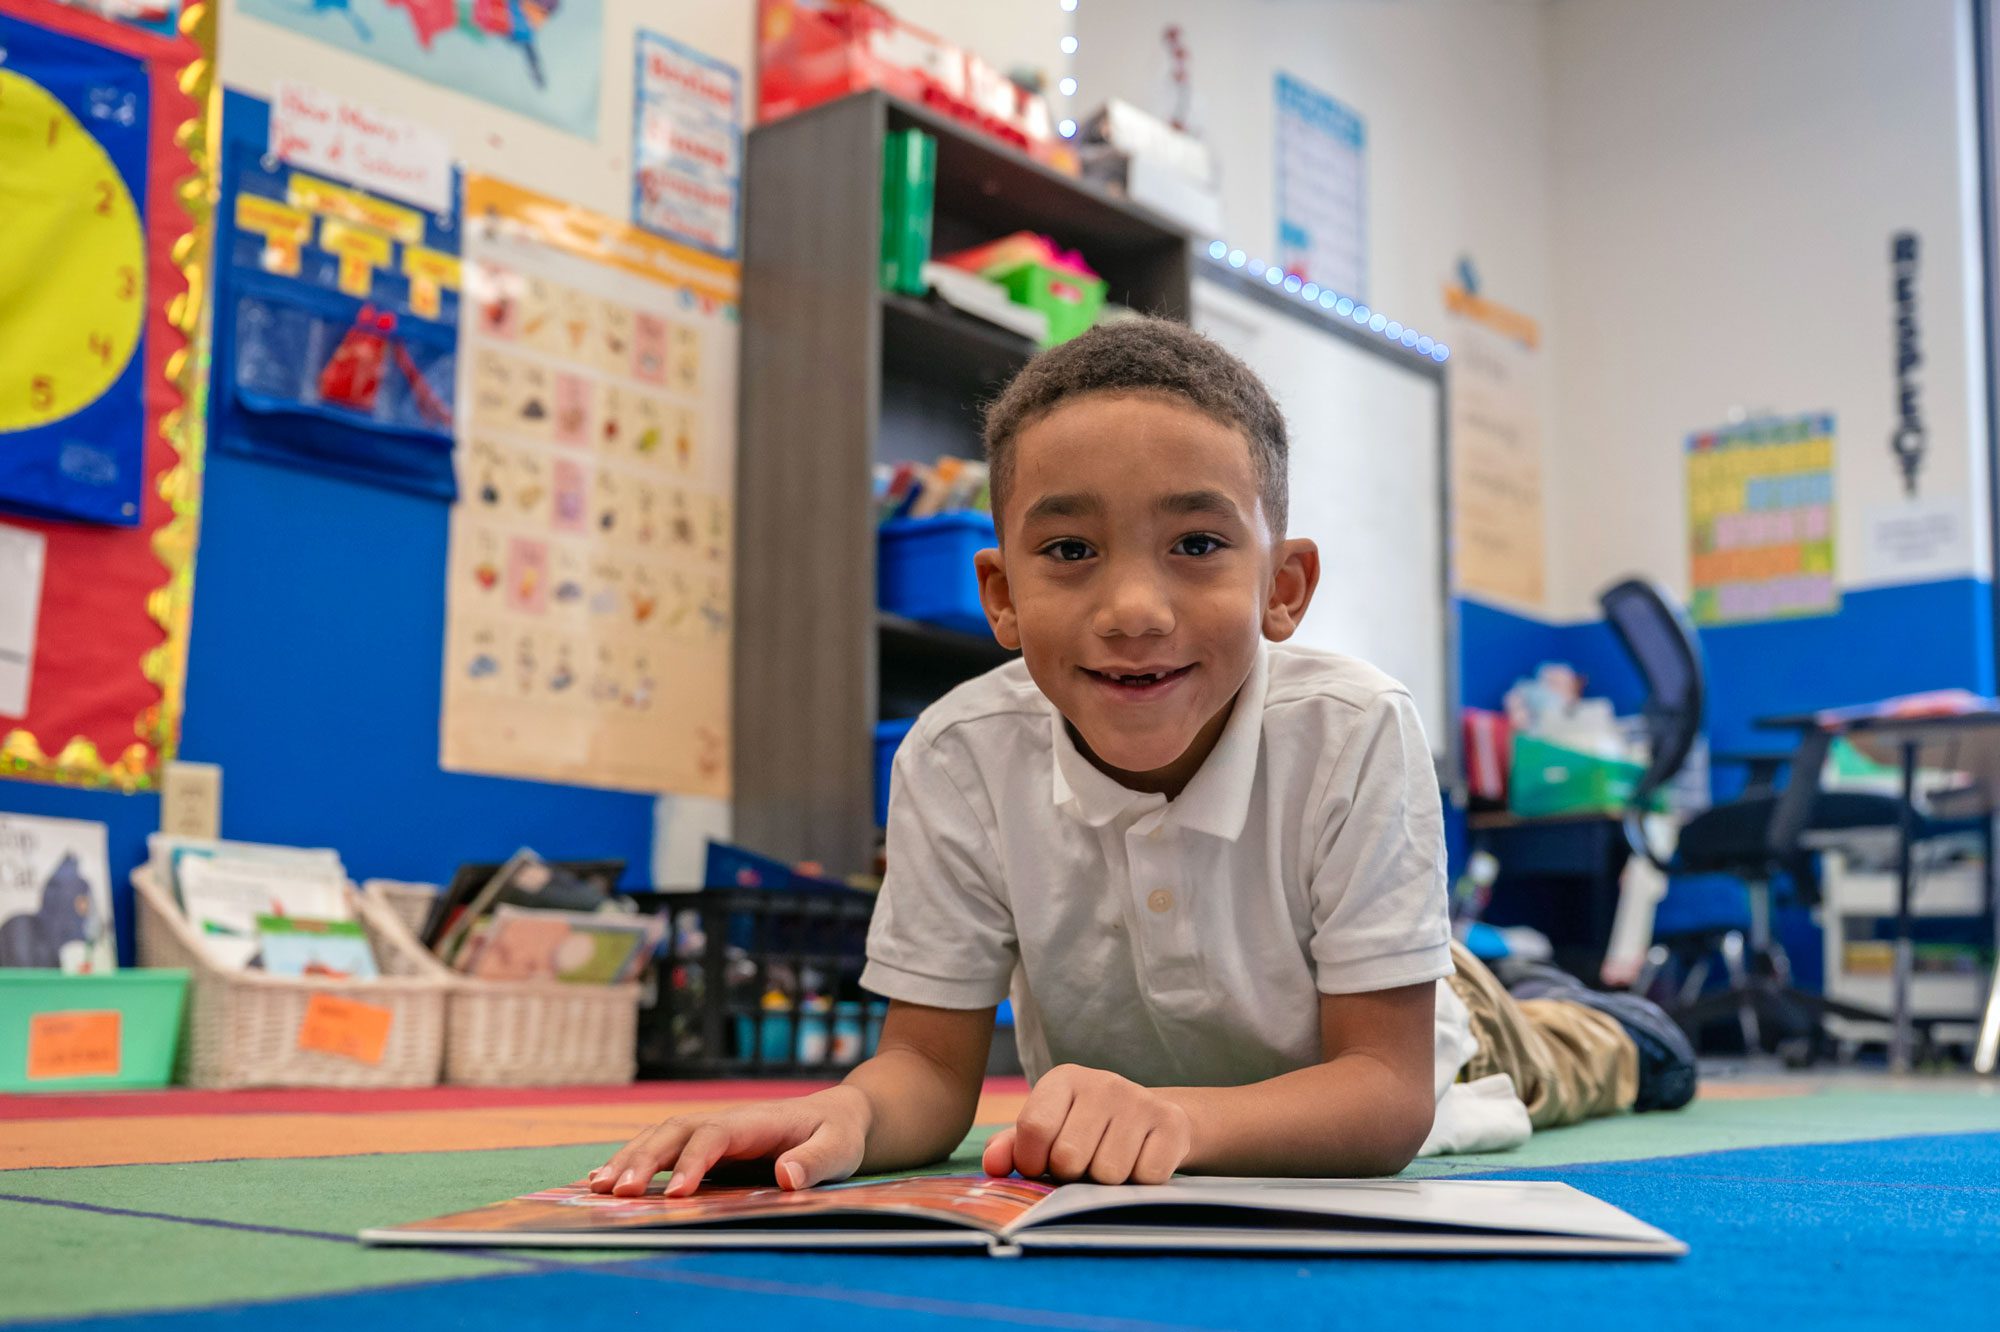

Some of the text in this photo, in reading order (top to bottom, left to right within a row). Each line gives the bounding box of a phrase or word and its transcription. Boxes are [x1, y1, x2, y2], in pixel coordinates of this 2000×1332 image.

[48, 116, 60, 148] 1
[96, 180, 116, 216] 2
[116, 264, 137, 302] 3
[88, 331, 114, 367] 4
[30, 373, 55, 412] 5
